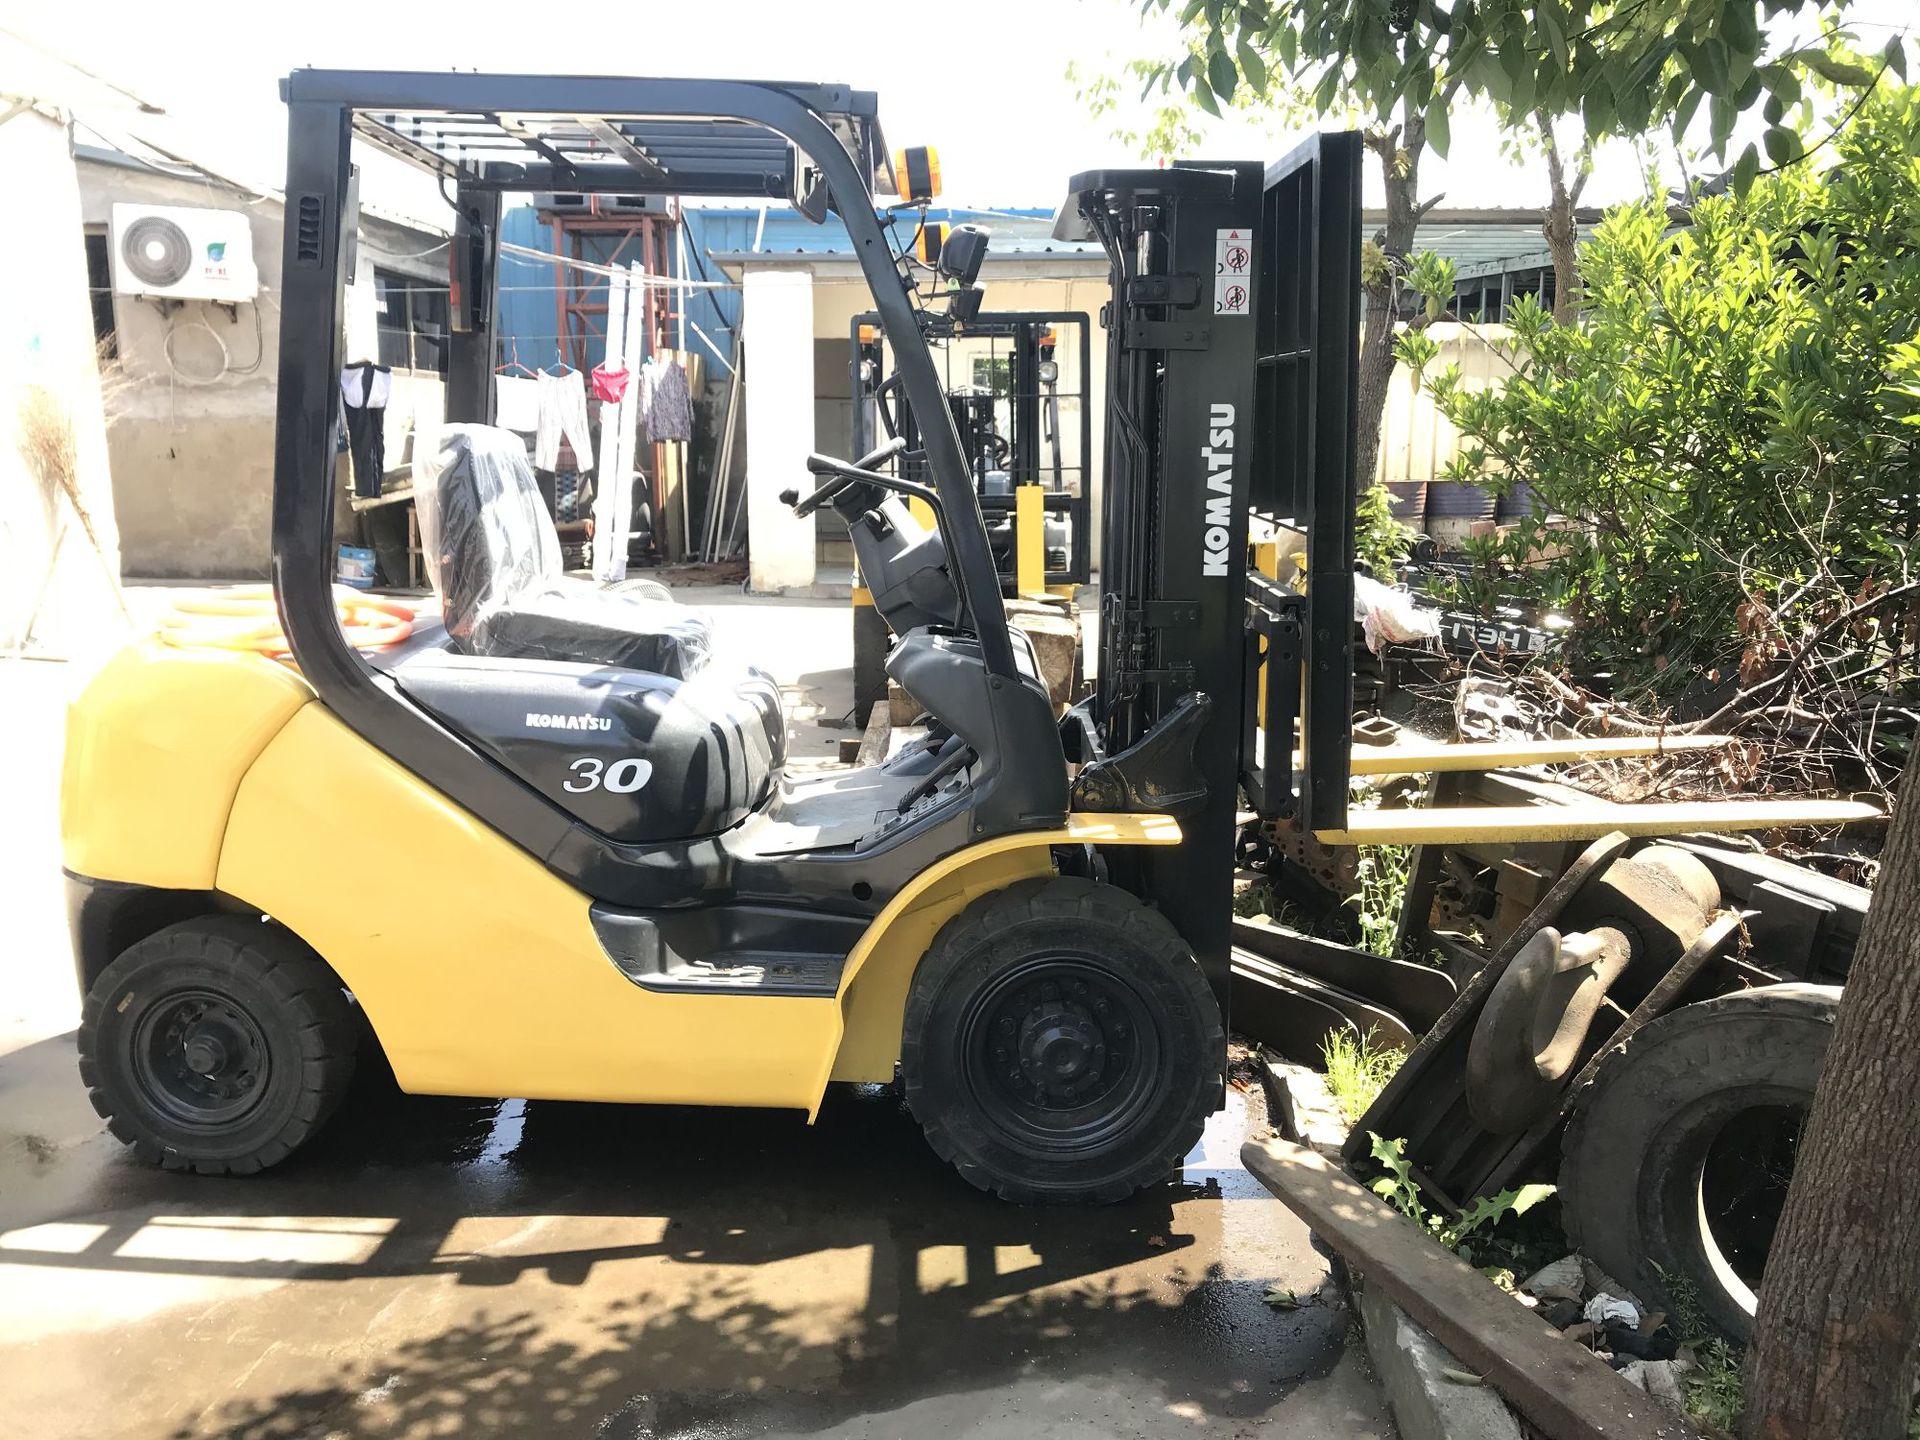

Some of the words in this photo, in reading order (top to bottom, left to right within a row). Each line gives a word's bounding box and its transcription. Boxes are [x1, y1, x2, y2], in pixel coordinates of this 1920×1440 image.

[1201, 403, 1235, 577] KOMATSU
[525, 713, 612, 731] KOMATSU
[562, 757, 653, 794] 30
